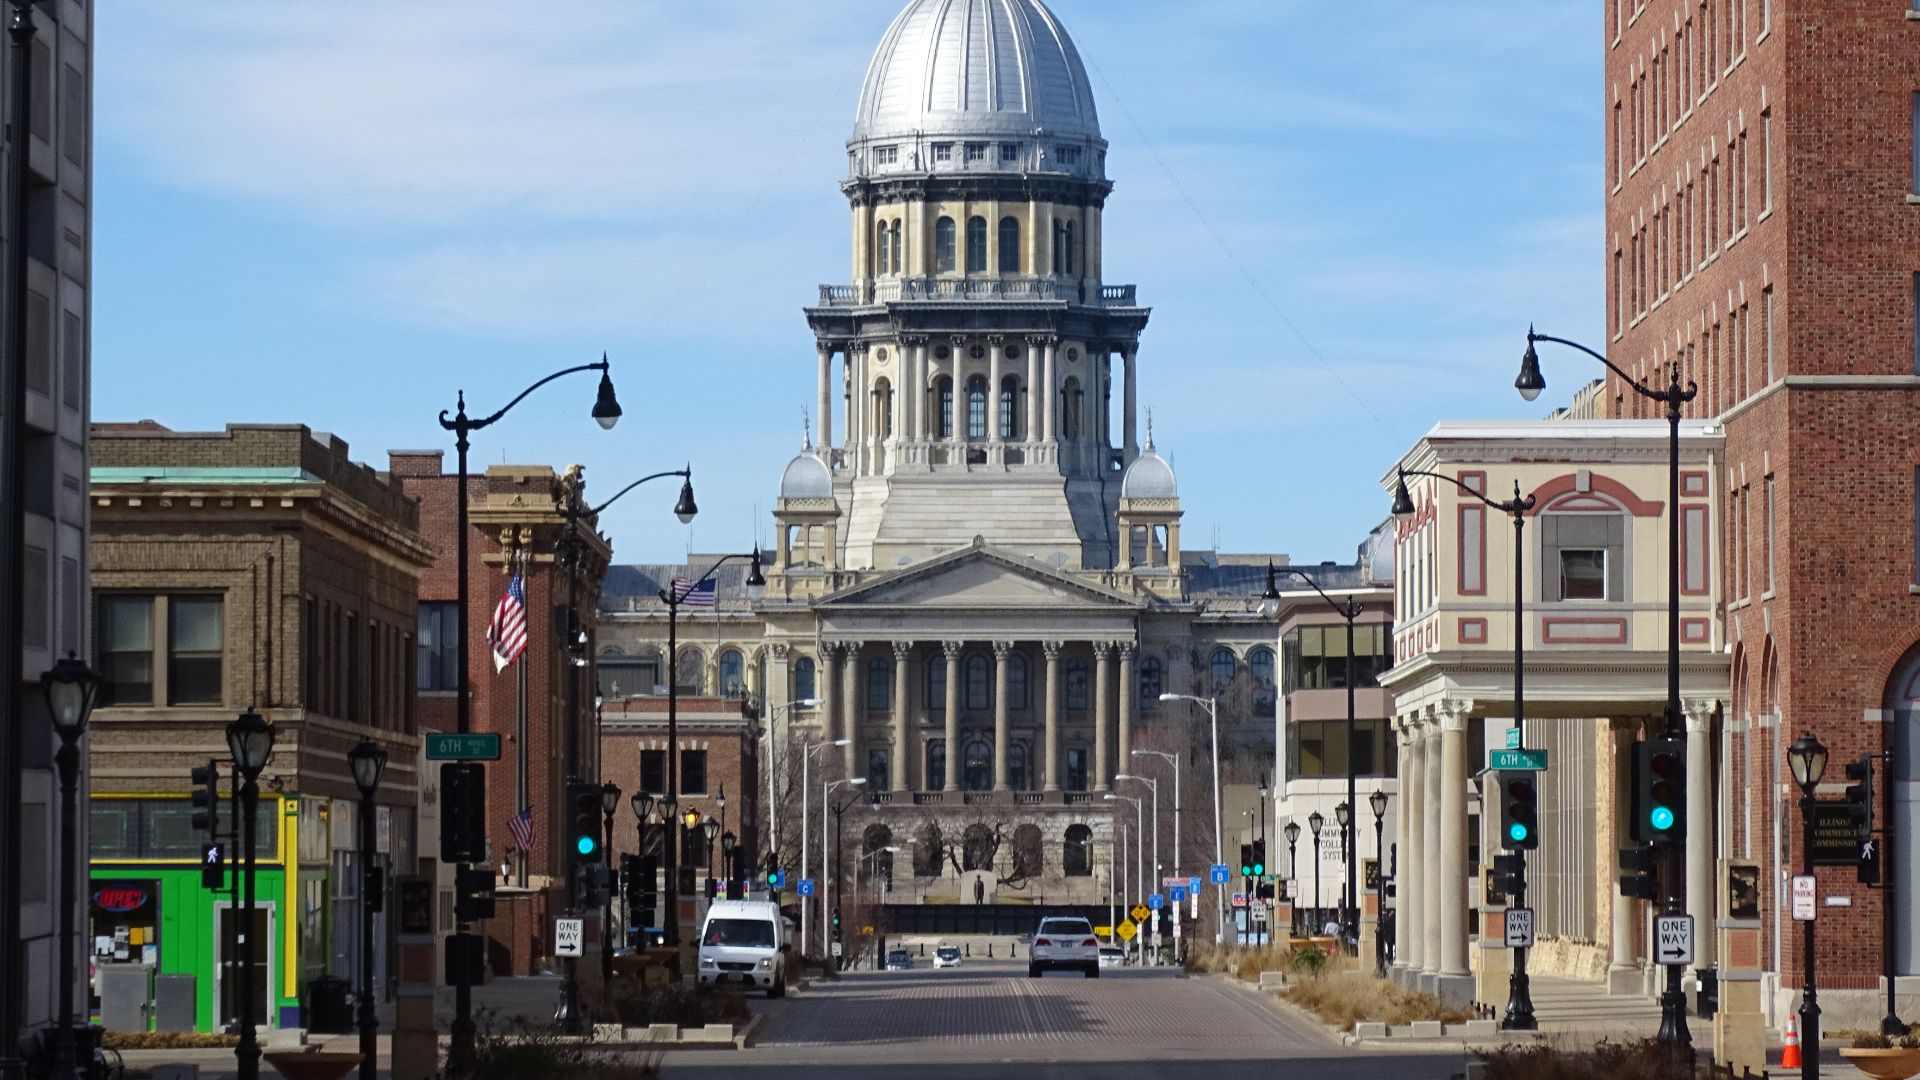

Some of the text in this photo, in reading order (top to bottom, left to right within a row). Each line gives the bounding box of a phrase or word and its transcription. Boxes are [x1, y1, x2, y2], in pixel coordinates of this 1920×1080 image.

[440, 739, 461, 753] 6TH
[1500, 754, 1518, 766] 6TH
[1320, 840, 1342, 849] COLL
[1815, 839, 1857, 848] OMMISSIO
[1323, 851, 1342, 860] SYST
[1217, 872, 1224, 882] B
[802, 885, 809, 894] C
[1799, 881, 1809, 889] NO
[1509, 913, 1529, 922] ONE
[559, 922, 579, 931] ONE
[1509, 923, 1529, 932] WAY
[1661, 920, 1687, 932] ONE
[558, 932, 579, 941] WAY
[1661, 933, 1688, 945] WAY
